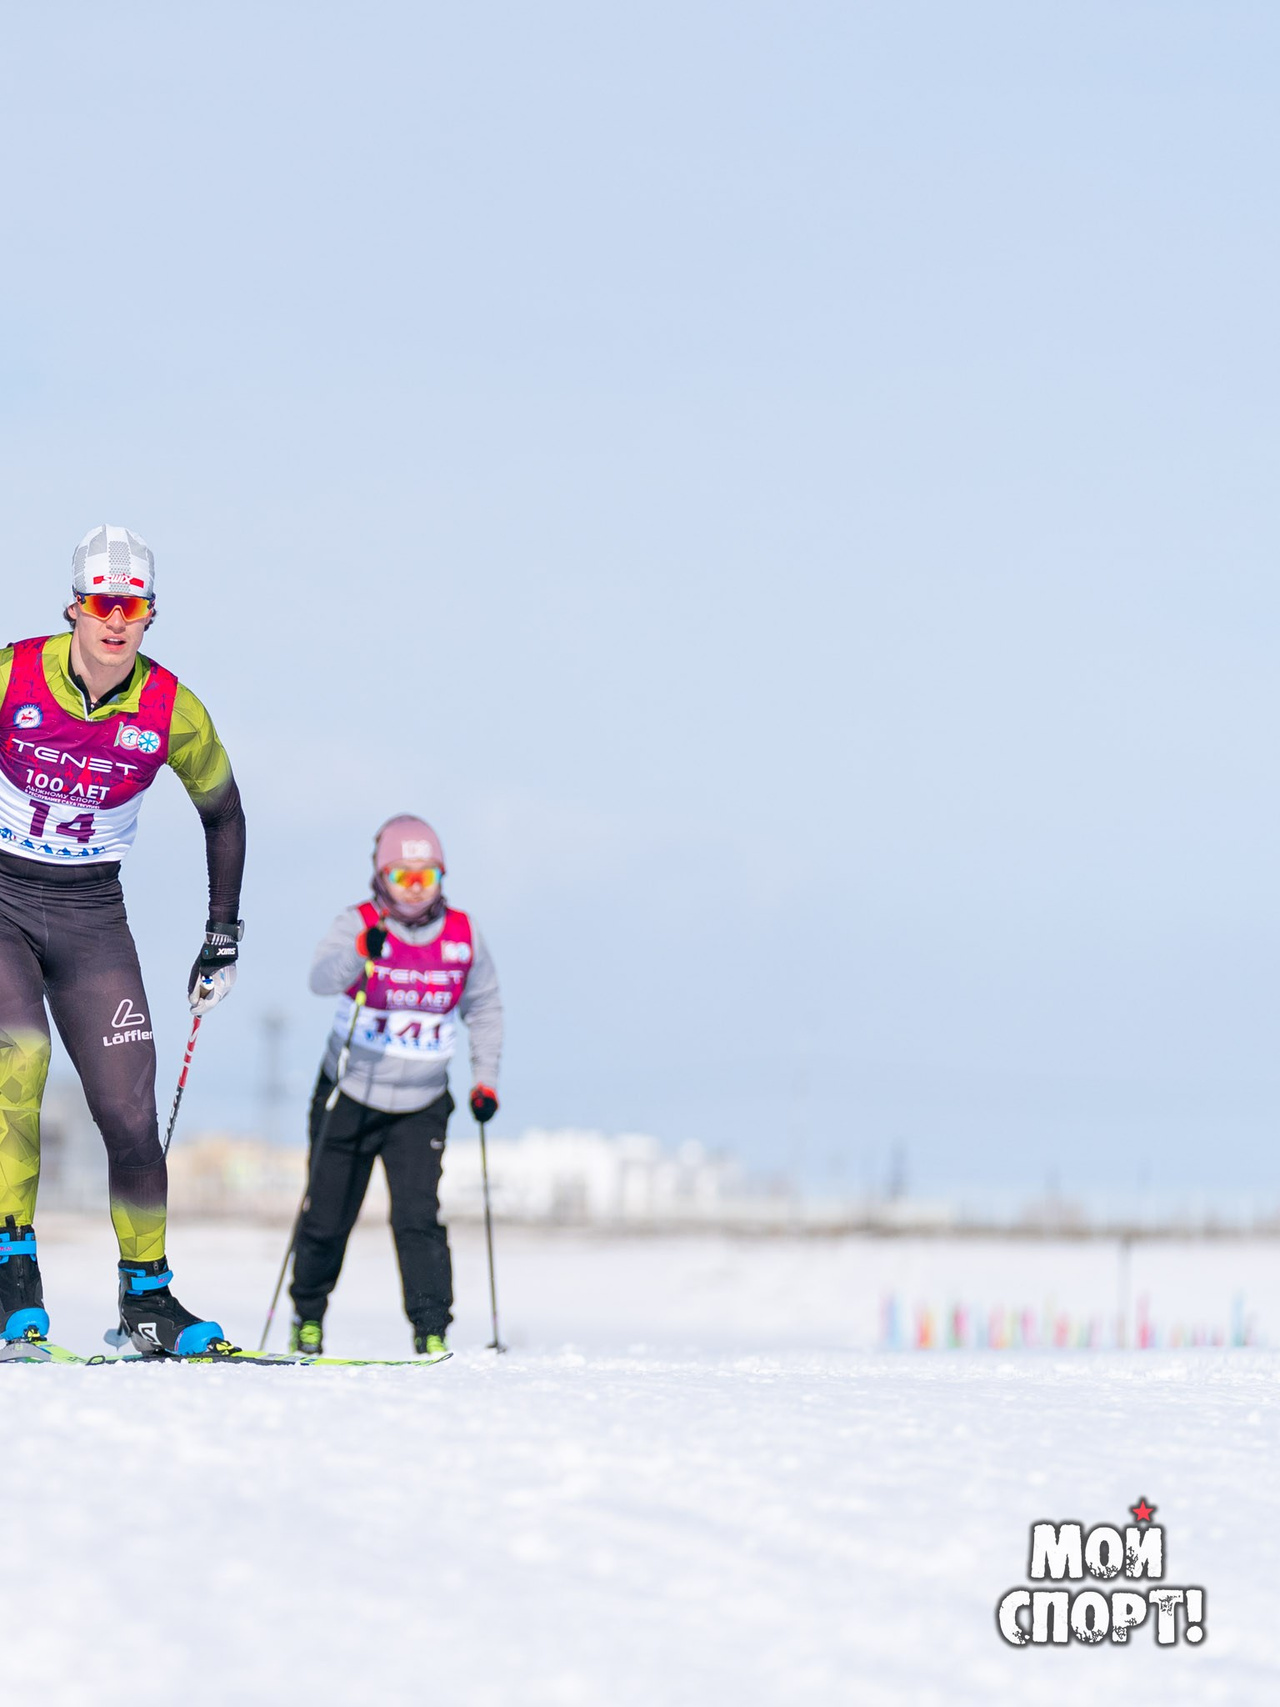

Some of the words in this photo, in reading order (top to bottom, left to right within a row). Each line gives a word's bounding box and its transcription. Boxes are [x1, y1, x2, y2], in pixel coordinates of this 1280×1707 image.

[11, 738, 138, 776] TENET
[26, 768, 64, 792] 100
[69, 782, 111, 801] ЛЕТ
[70, 795, 102, 806] СПОРТУ
[29, 799, 96, 843] 14
[373, 965, 463, 984] TENET
[385, 988, 419, 1006] 100
[420, 990, 452, 1007] ЛЕТ
